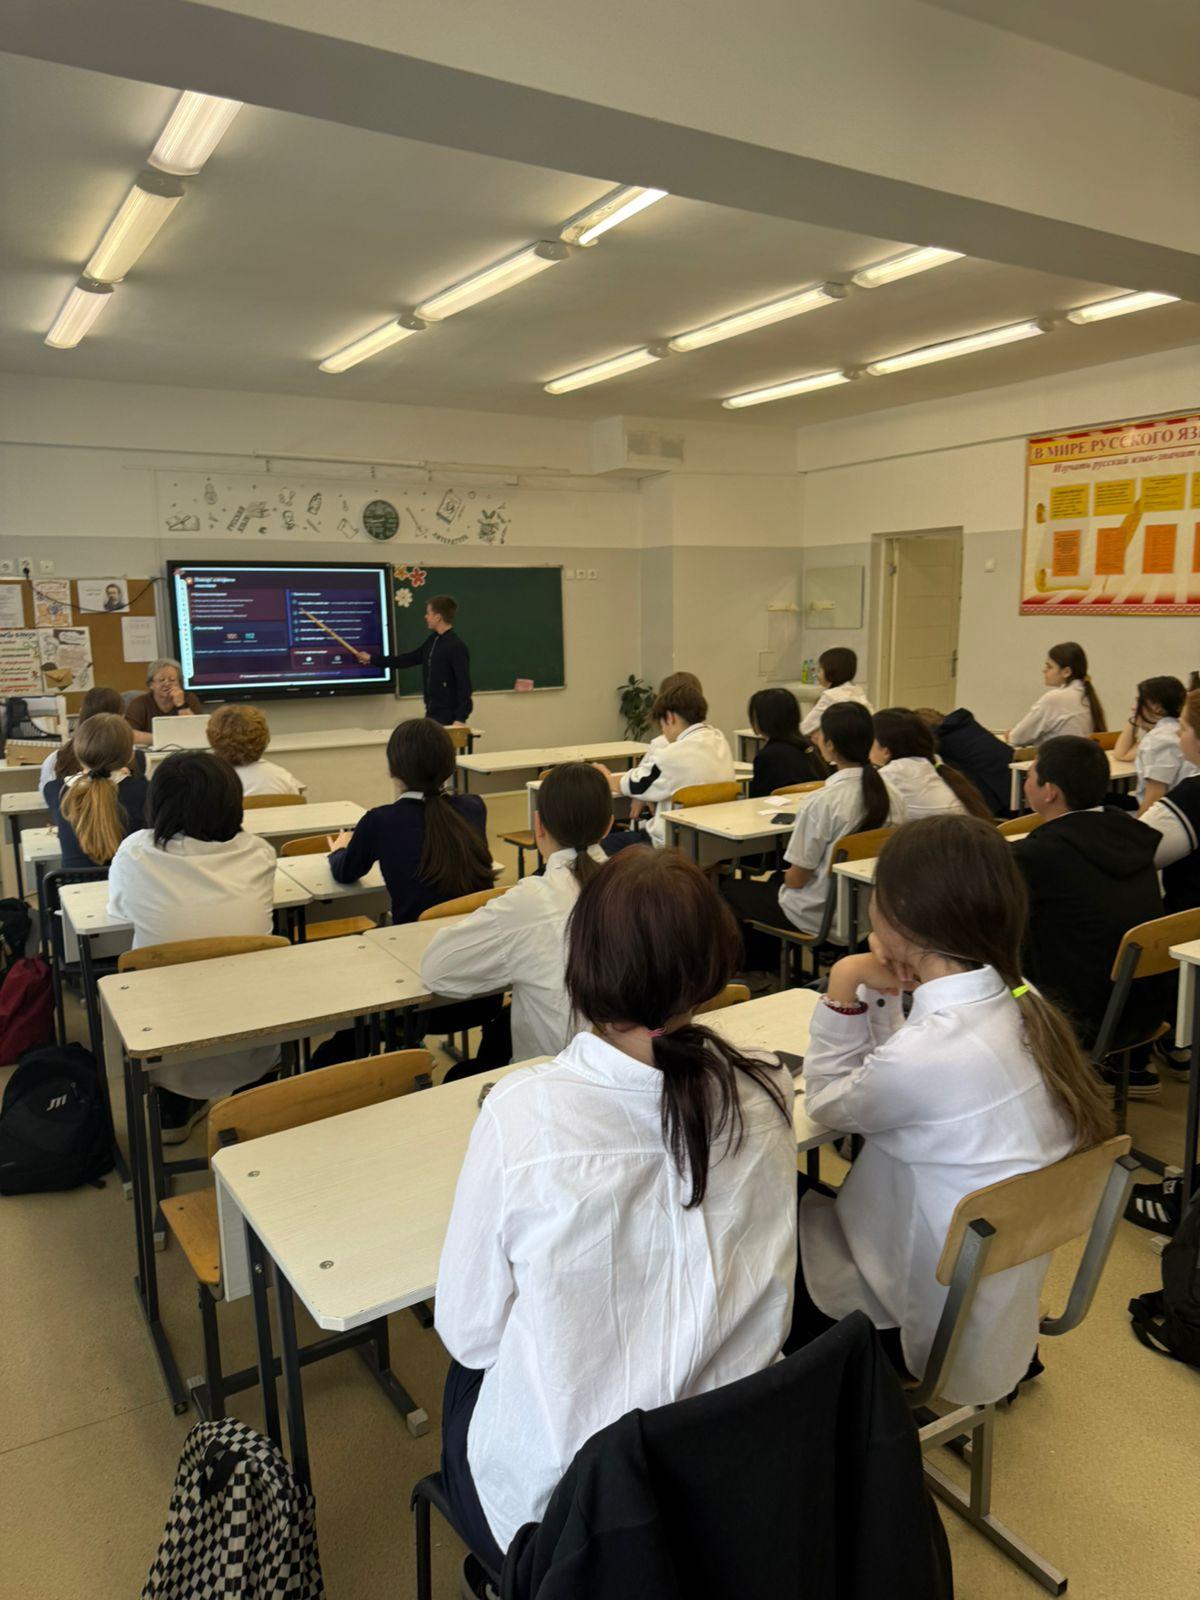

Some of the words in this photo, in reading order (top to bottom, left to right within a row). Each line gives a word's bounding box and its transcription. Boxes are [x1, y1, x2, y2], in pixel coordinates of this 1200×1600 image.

[1034, 447, 1044, 459] В
[1047, 441, 1088, 457] МИРЕ
[1091, 428, 1174, 452] РУССКОГО
[1177, 425, 1200, 441] ЯЗ
